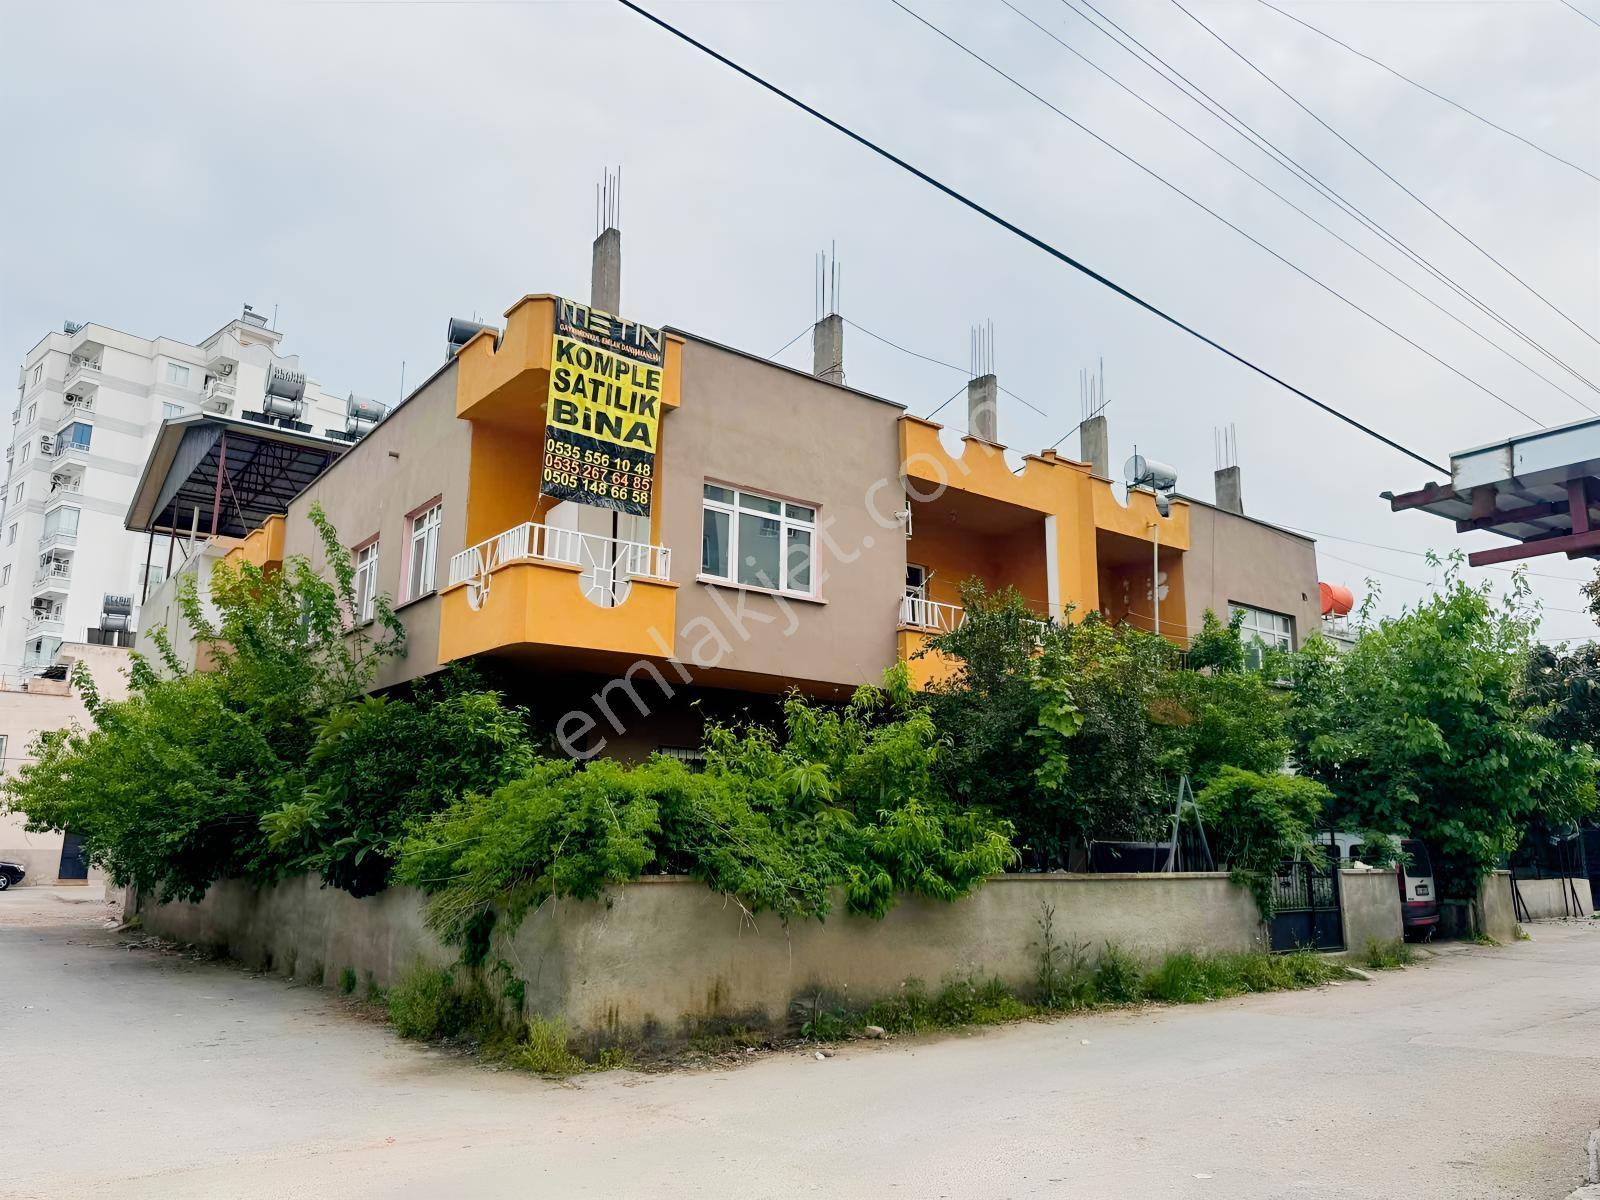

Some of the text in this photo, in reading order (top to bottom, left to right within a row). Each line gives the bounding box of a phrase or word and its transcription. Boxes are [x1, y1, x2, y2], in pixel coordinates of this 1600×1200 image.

[556, 340, 661, 392] KOMPLE
[553, 368, 658, 419] SATILIK
[545, 454, 650, 491] 0535 267 64 85
[546, 438, 651, 477] 0535 556 10 48
[543, 469, 648, 505] 0505 148 66 58
